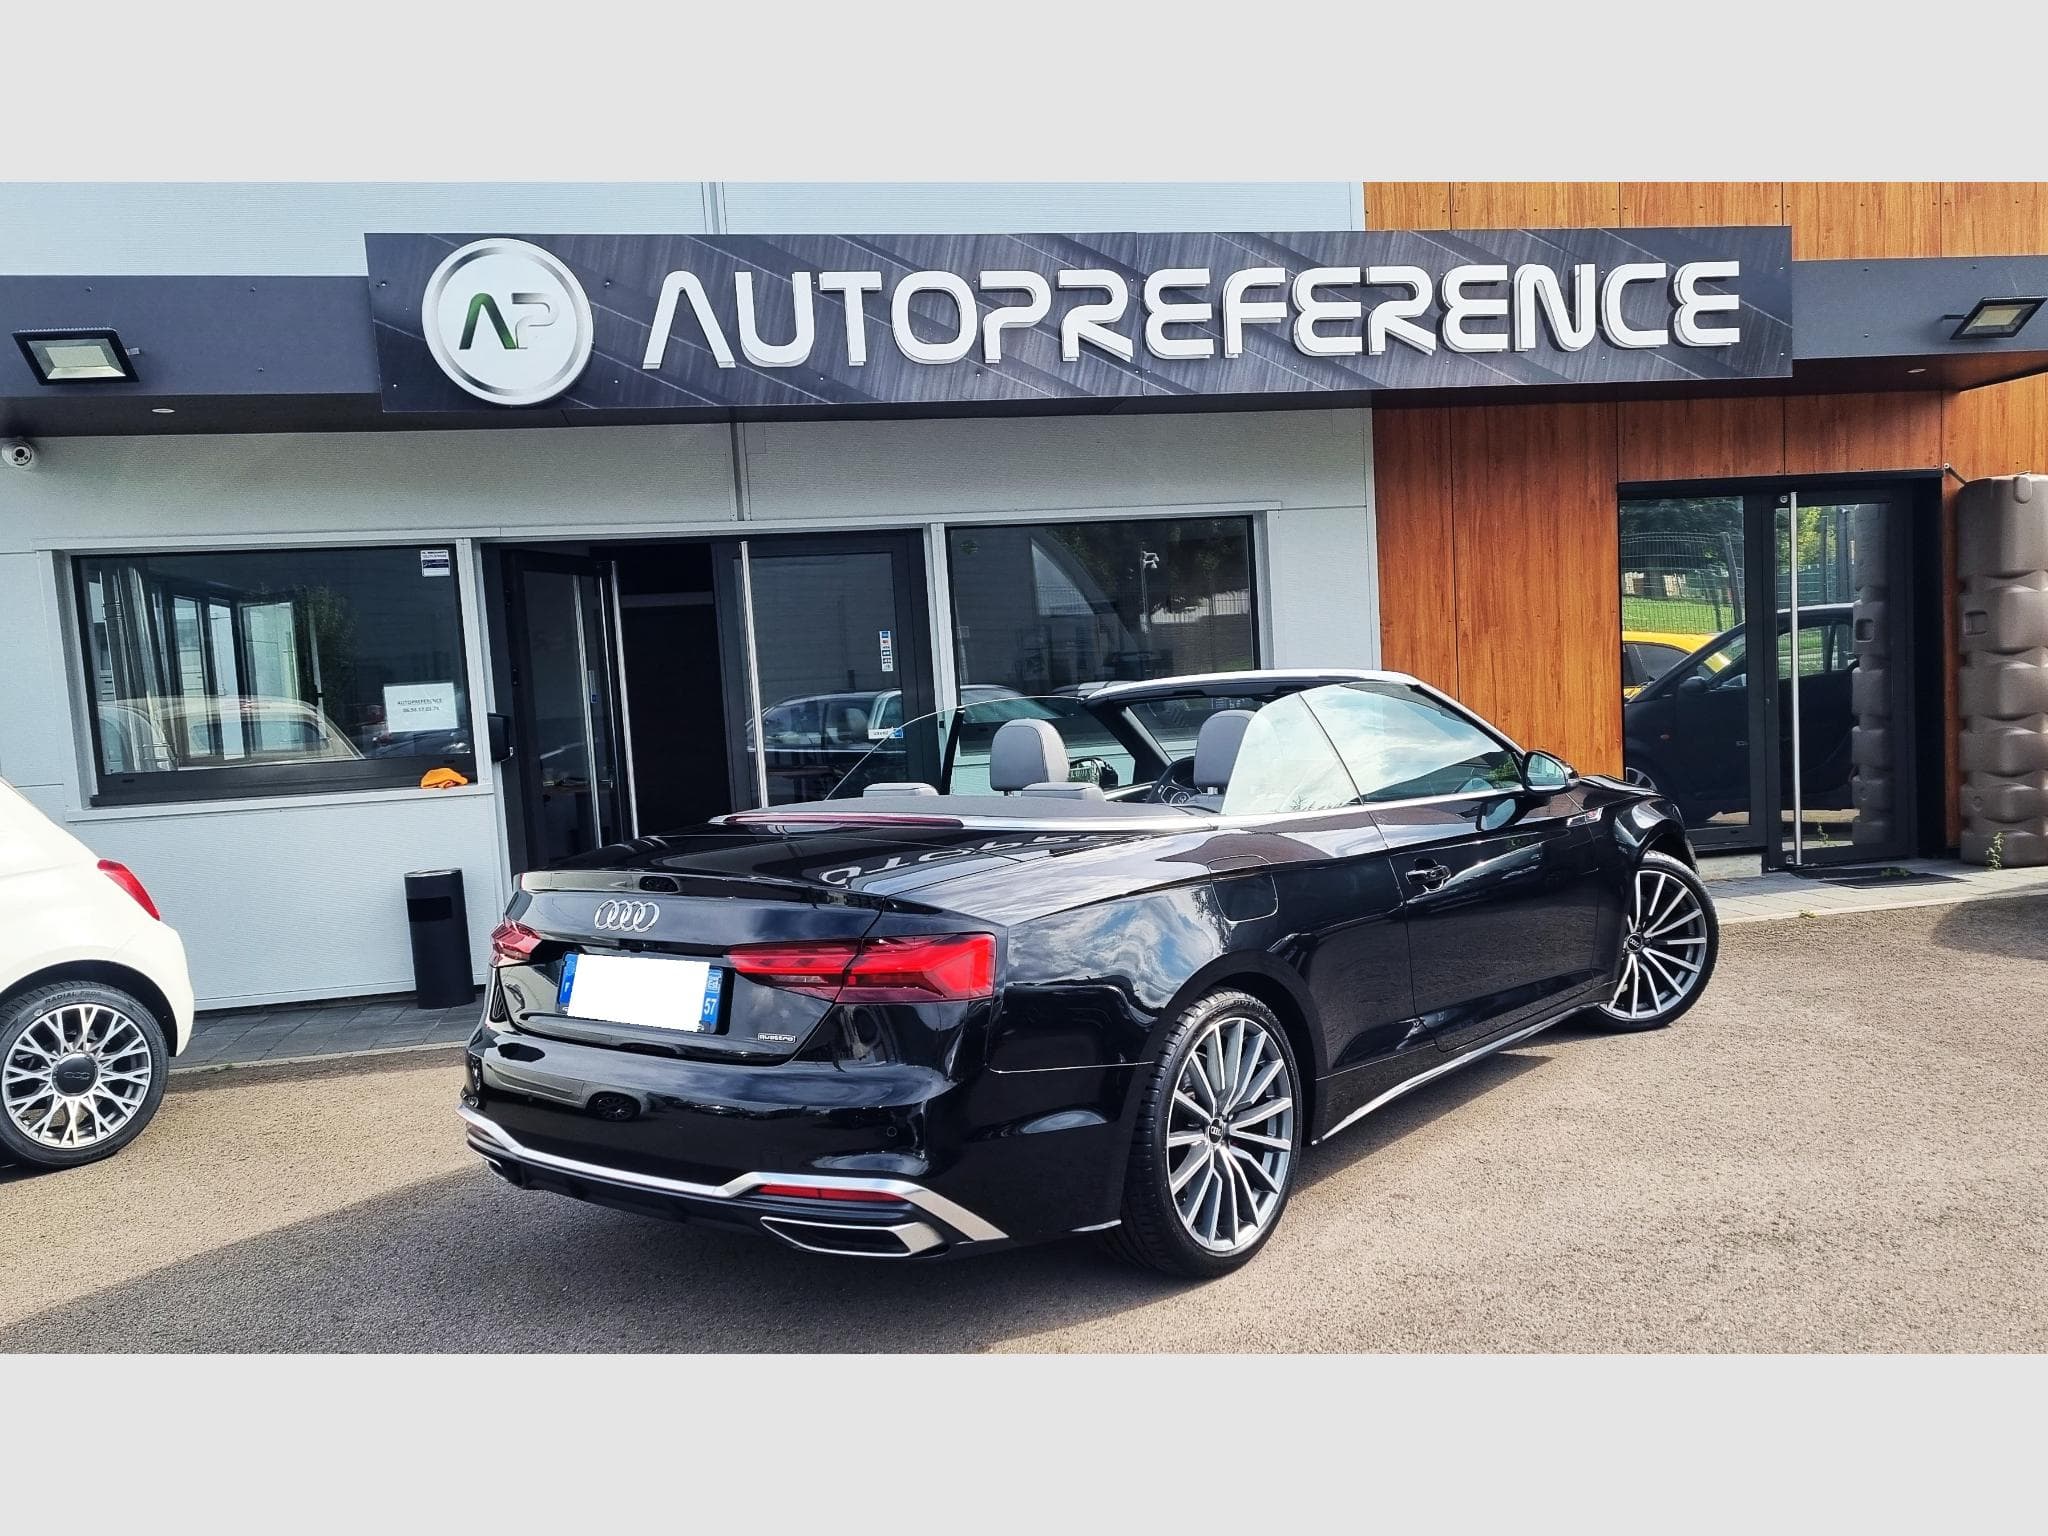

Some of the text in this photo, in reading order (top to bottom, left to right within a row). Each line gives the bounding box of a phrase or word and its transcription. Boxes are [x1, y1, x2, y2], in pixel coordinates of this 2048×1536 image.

[458, 292, 560, 350] AP
[642, 261, 1740, 370] AUTOPREFERENCE
[704, 998, 717, 1015] 57
[759, 1034, 794, 1042] quattro
